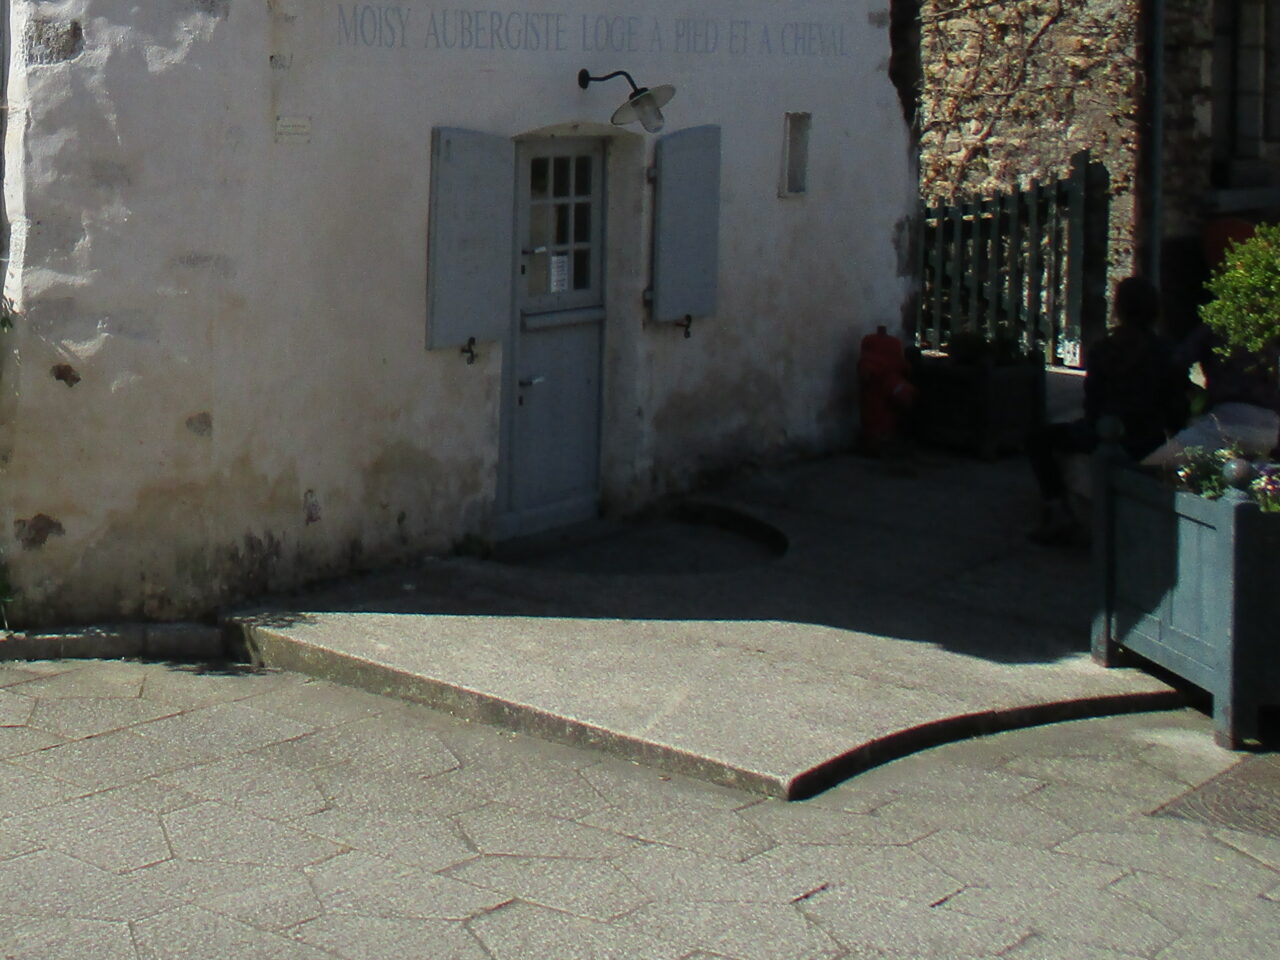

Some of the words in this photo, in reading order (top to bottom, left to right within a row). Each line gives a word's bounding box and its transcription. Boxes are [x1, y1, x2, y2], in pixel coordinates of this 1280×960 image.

[337, 3, 412, 49] MOISY
[425, 8, 568, 52] AUBERGISTE
[581, 14, 639, 53] LOGE
[675, 18, 719, 54] PIED
[729, 20, 751, 54] ET
